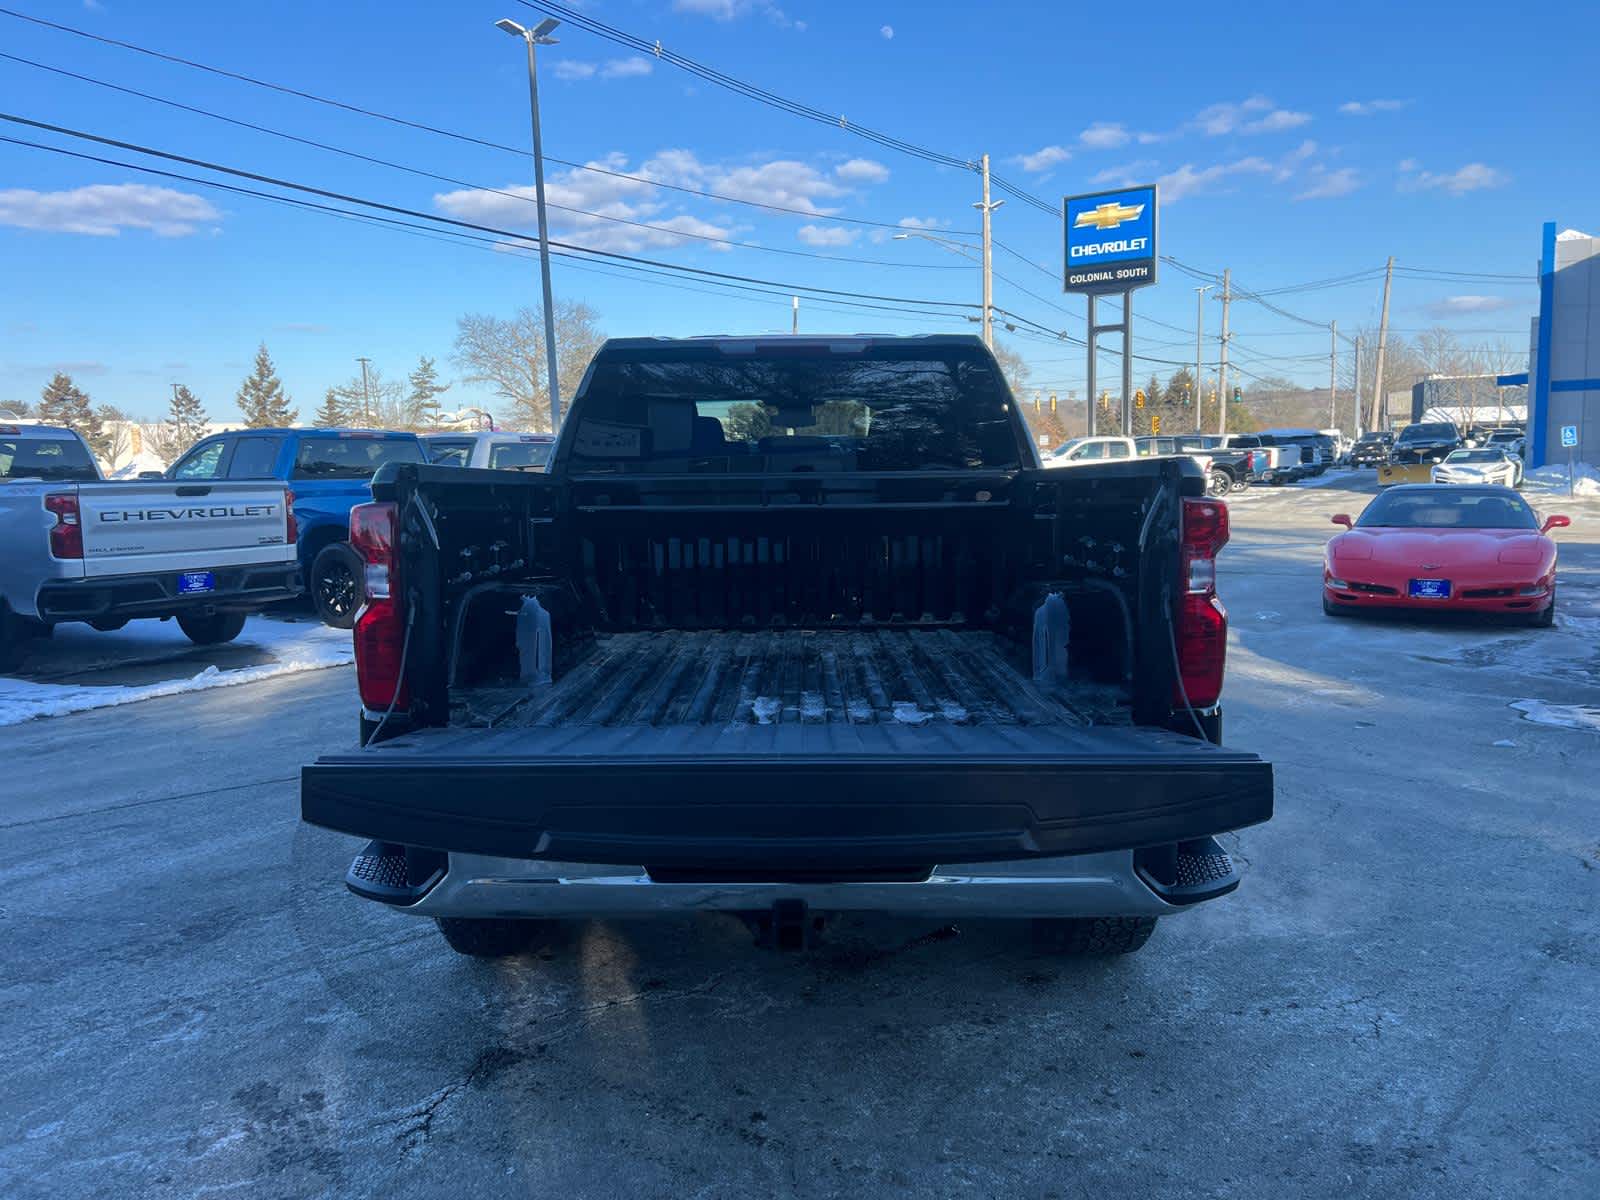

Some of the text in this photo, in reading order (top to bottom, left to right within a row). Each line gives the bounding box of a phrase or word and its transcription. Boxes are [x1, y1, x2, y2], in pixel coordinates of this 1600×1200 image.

[1071, 237, 1148, 257] CHEVROLET
[1070, 267, 1148, 284] COLONIAL SOUTH
[100, 505, 276, 522] CHEVROLET
